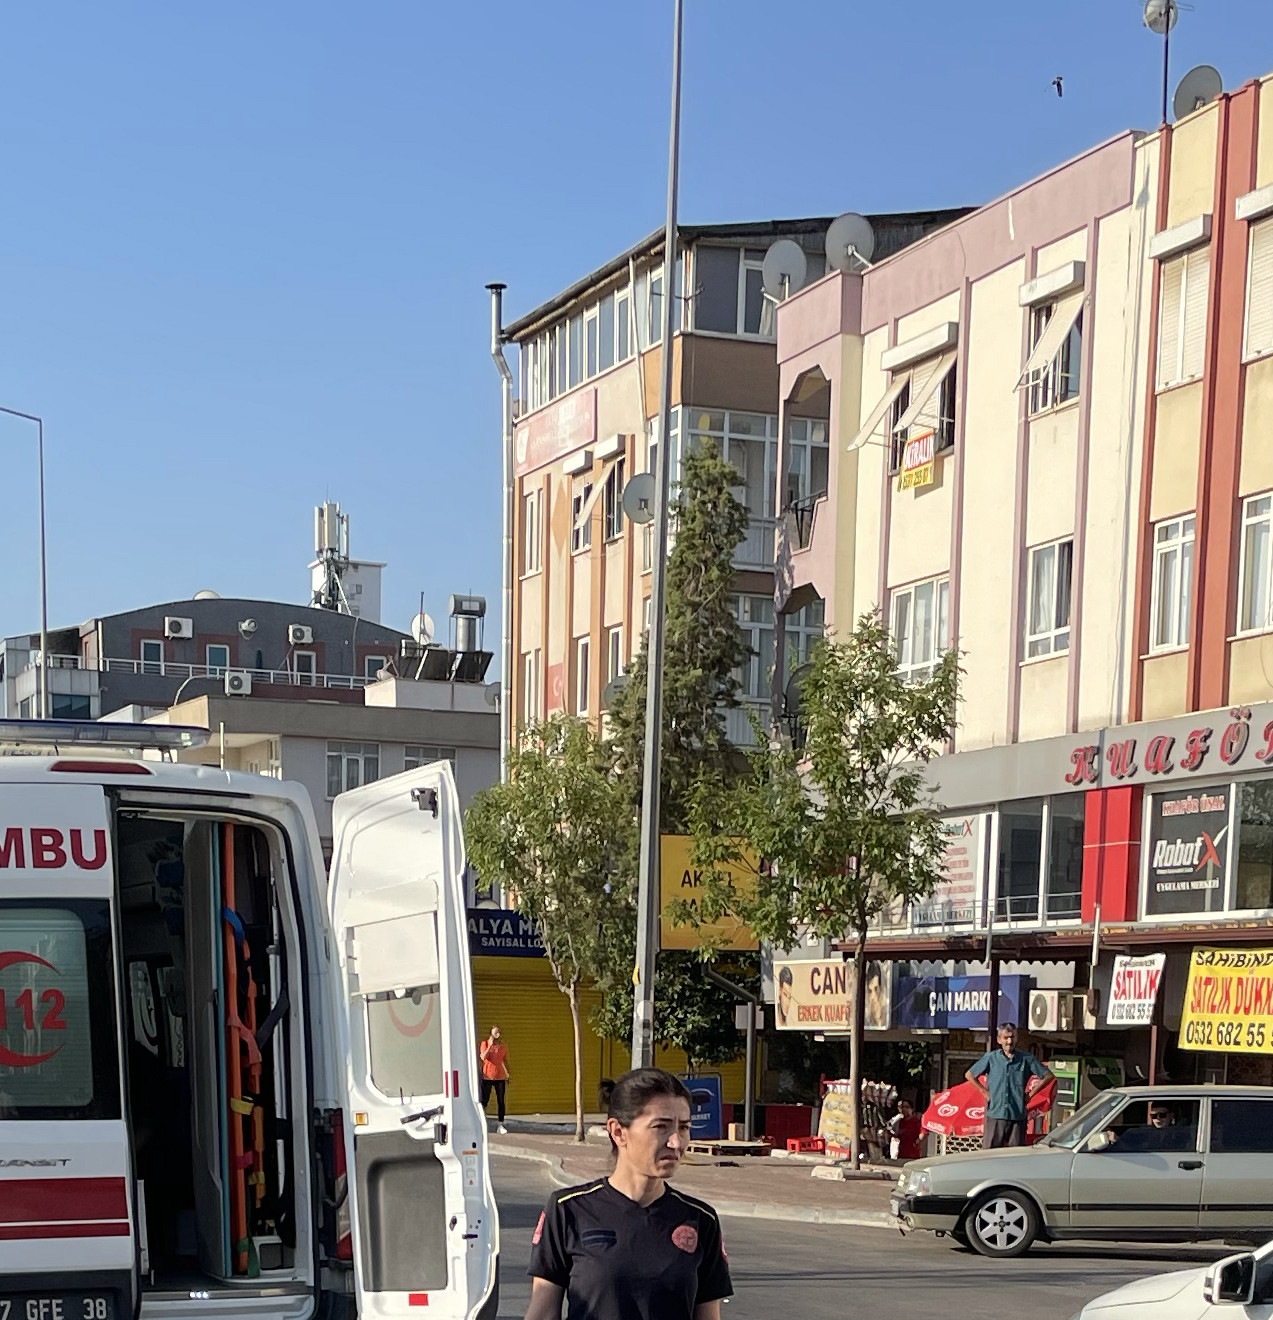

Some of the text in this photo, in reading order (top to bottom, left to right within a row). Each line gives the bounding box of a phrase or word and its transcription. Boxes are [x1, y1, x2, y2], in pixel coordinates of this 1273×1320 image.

[1153, 825, 1228, 872] RobotX
[481, 937, 525, 948] SAYISAL
[811, 967, 846, 995] CAN
[1113, 969, 1161, 1001] SATILIK
[955, 990, 1003, 1012] MARK
[1191, 976, 1232, 1015] SATILIK
[824, 1001, 851, 1022] KUAFÖ
[1186, 1020, 1213, 1045] 0532
[1217, 1022, 1243, 1046] 682
[1246, 1023, 1266, 1047] 55
[26, 1299, 65, 1320] GFE
[83, 1298, 107, 1320] 38
